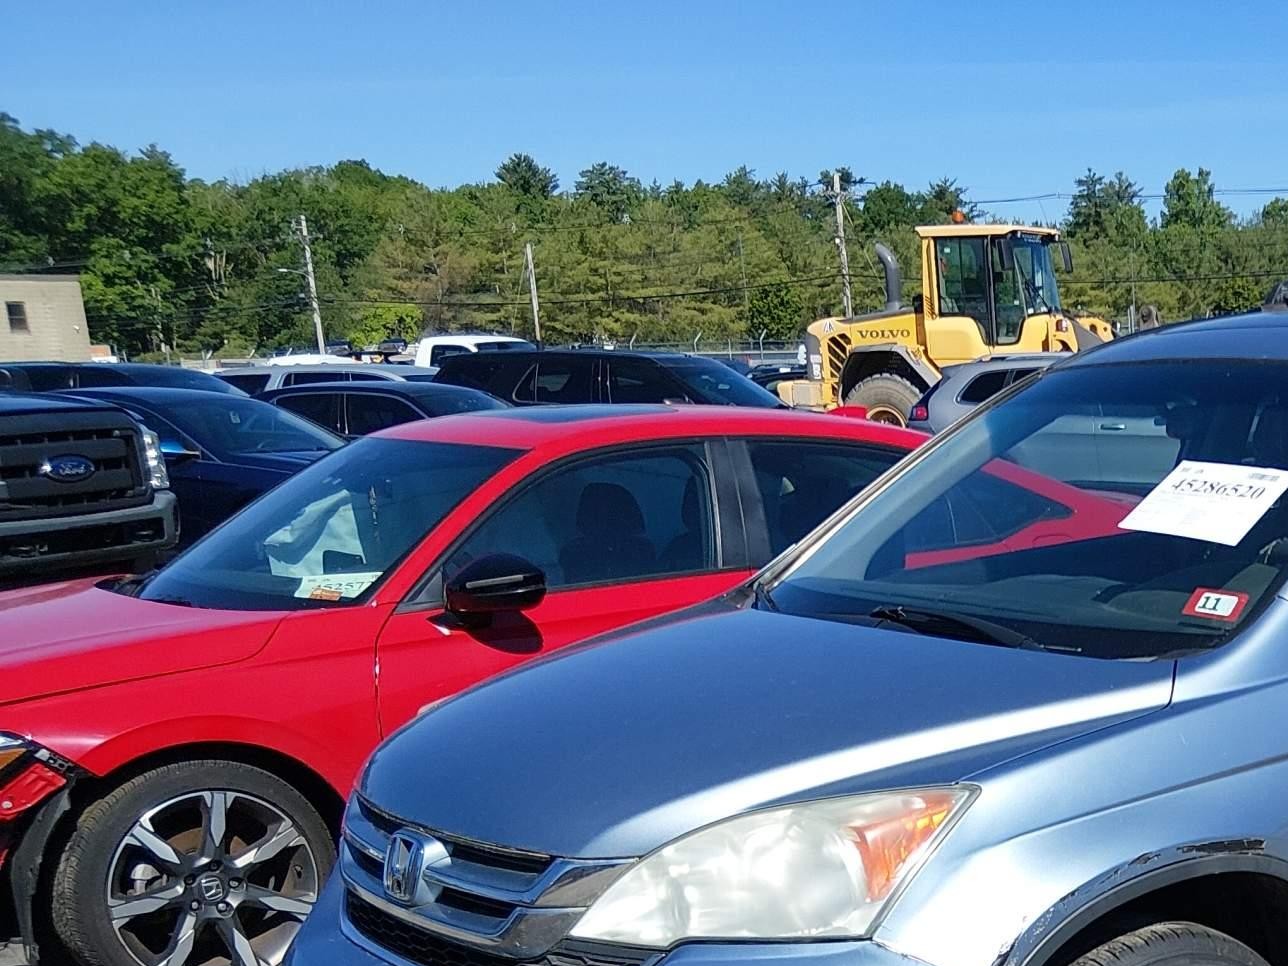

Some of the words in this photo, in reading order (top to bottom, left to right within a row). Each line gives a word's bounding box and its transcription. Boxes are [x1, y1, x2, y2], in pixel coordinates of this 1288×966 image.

[857, 329, 911, 339] VOLVO
[1172, 478, 1266, 499] 45286520
[1197, 596, 1221, 612] 11
